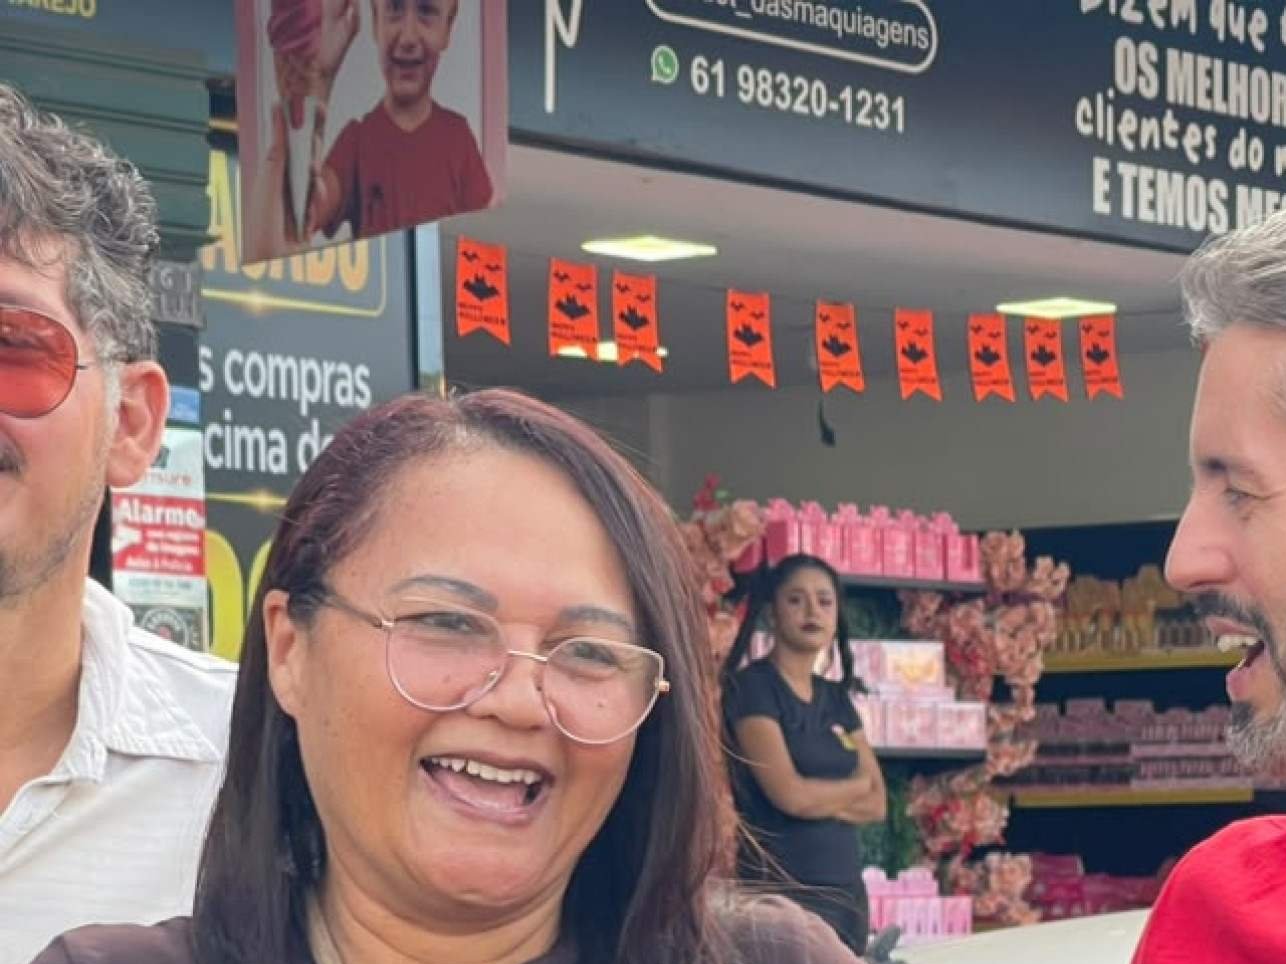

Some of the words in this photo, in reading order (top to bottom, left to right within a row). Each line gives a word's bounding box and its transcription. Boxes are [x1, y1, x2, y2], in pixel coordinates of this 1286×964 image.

[1209, 0, 1269, 52] que
[691, 55, 724, 97] 61
[737, 65, 905, 133] 98320-1231
[1114, 36, 1159, 100] OS
[1075, 86, 1217, 164] clientes
[1228, 127, 1264, 172] do
[1092, 156, 1112, 216] E
[1117, 161, 1229, 234] TEMOS
[224, 348, 373, 417] compras
[204, 407, 289, 475] cima
